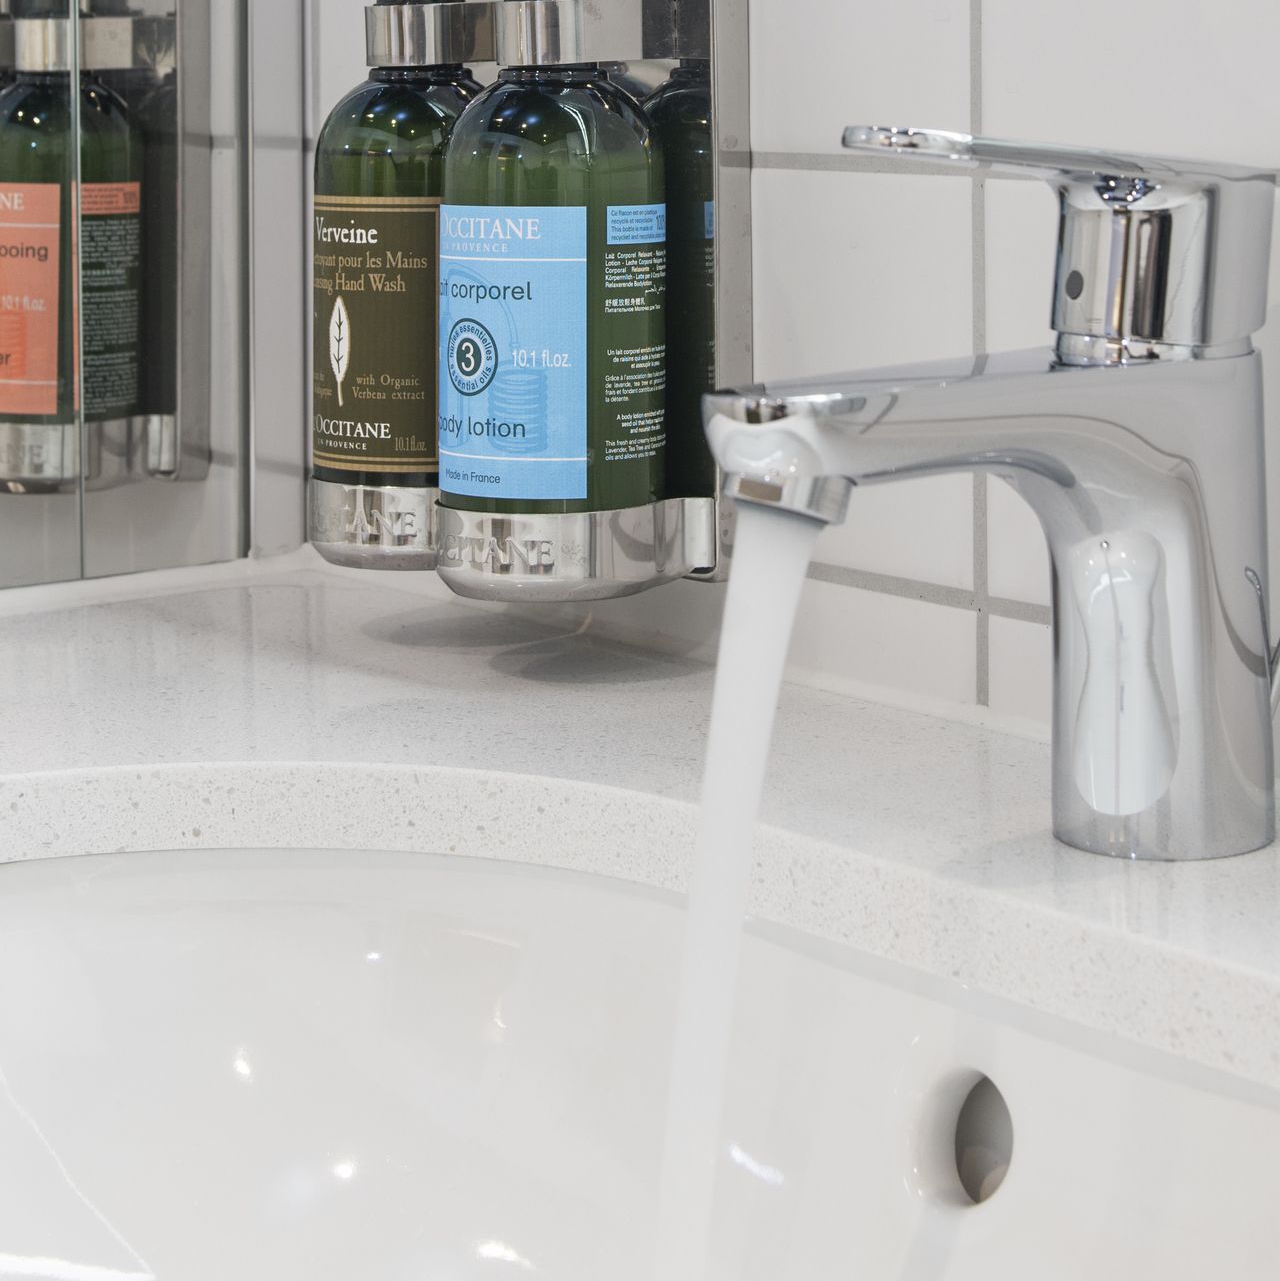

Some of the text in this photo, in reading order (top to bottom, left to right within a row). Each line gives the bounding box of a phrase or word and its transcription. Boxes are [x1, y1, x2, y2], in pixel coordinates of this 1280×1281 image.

[316, 216, 378, 244] Verveine
[338, 255, 362, 273] pour
[366, 251, 382, 268] les
[385, 251, 428, 268] Mains
[335, 273, 365, 291] Hand
[368, 273, 406, 292] Wash
[451, 281, 533, 303] corporel
[459, 324, 493, 362] essentielles
[461, 341, 475, 372] 3
[512, 349, 537, 368] 10.1
[356, 374, 420, 390] with Organic
[450, 364, 493, 391] essential oils
[352, 386, 425, 400] Verbena extract
[468, 417, 526, 437] lotion
[325, 439, 368, 450] PROVENCE
[462, 470, 469, 481] in
[470, 472, 501, 484] France
